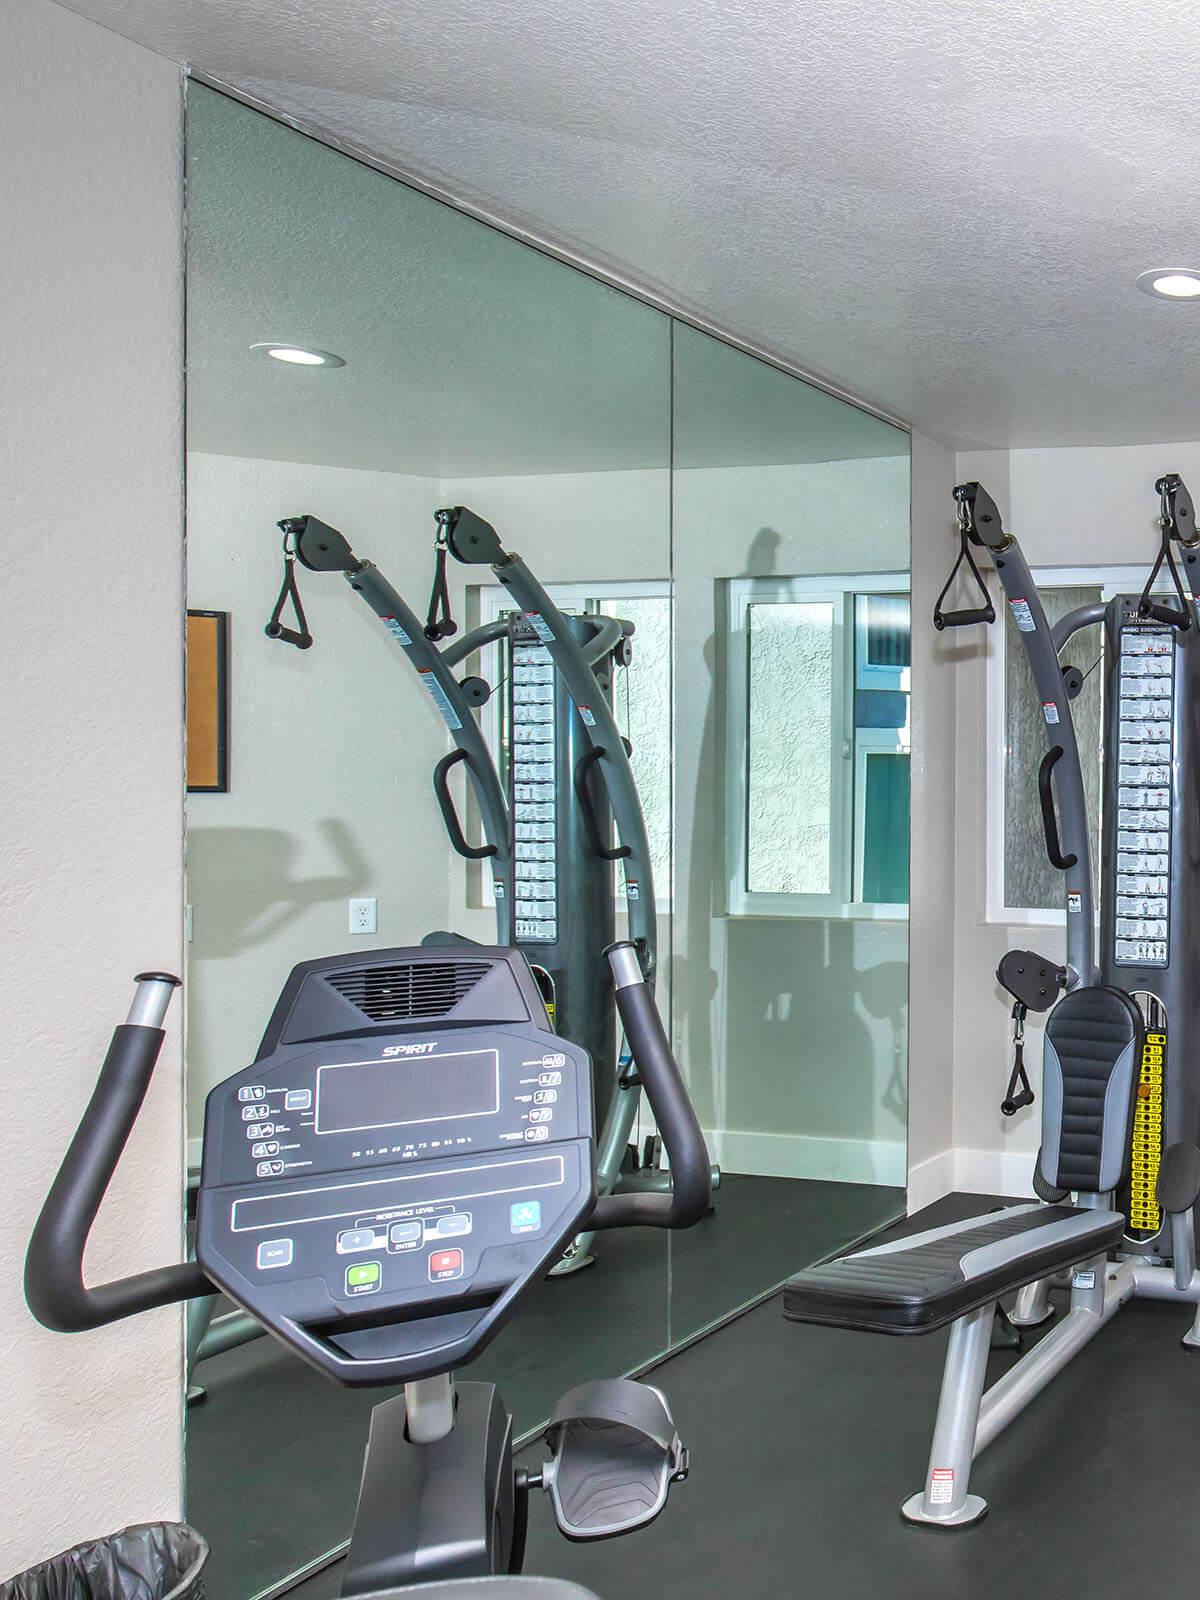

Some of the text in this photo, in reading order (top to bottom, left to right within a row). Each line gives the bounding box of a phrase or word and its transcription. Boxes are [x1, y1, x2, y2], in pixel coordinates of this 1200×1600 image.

[382, 1042, 438, 1057] SPIRIT
[376, 1206, 435, 1220] RESISTANCE LEVEL
[394, 1241, 417, 1250] ENTER
[437, 1270, 455, 1278] STOP
[353, 1283, 374, 1293] START
